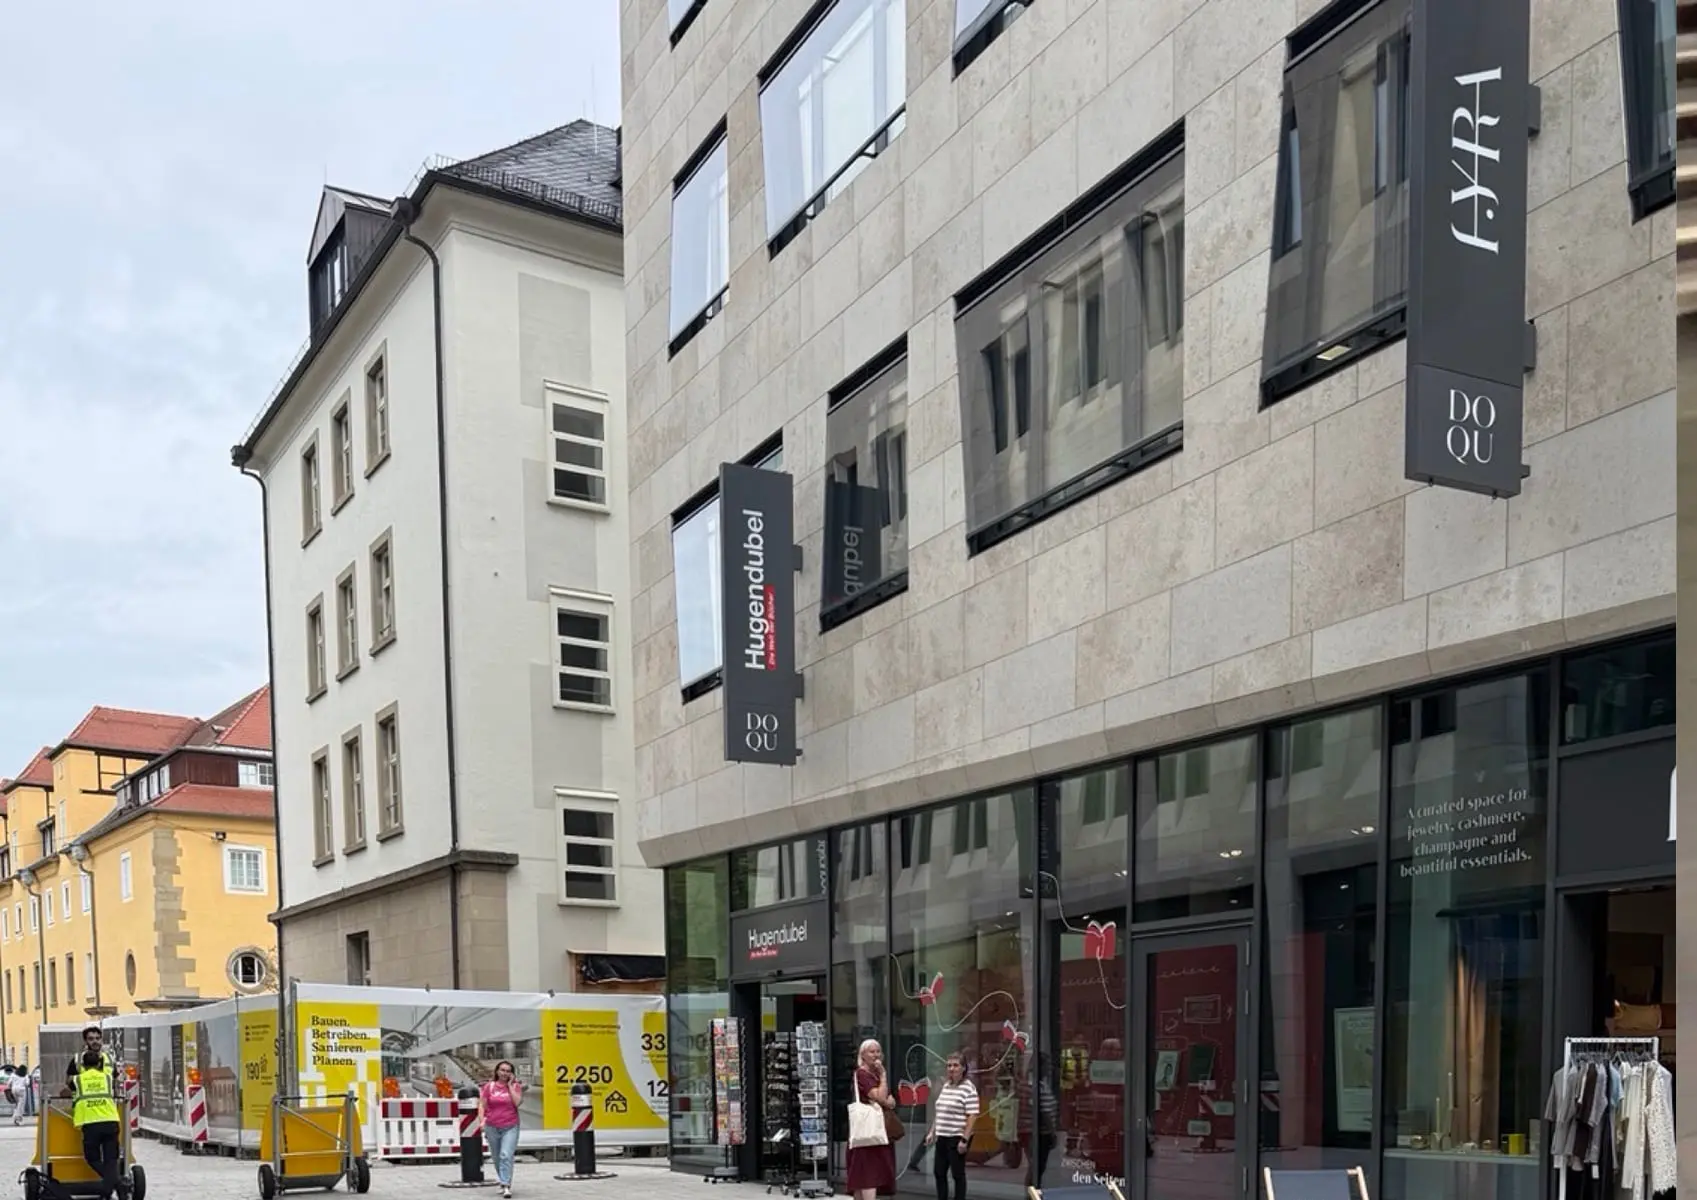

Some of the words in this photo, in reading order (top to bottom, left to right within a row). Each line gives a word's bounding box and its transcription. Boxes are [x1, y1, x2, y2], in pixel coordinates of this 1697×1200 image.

[1449, 389, 1496, 429] DO
[1447, 425, 1494, 464] QU
[742, 509, 769, 670] Hugendubel
[747, 712, 778, 732] DO
[745, 731, 778, 752] QU
[1417, 797, 1464, 818] curated
[1467, 793, 1505, 811] space
[1508, 788, 1528, 802] for
[1415, 838, 1488, 856] champagne
[1490, 828, 1517, 846] and
[1400, 857, 1457, 877] beautiful
[1460, 848, 1532, 869] essentials.
[748, 919, 808, 952] Hugendubel
[311, 1015, 350, 1027] Bauen.
[312, 1029, 371, 1040] Betreiben.
[641, 1033, 666, 1051] 33
[312, 1042, 367, 1053] Sanieren.
[312, 1055, 357, 1066] Planen.
[556, 1065, 613, 1084] 2.250
[647, 1080, 669, 1097] 12
[1072, 1169, 1091, 1184] den
